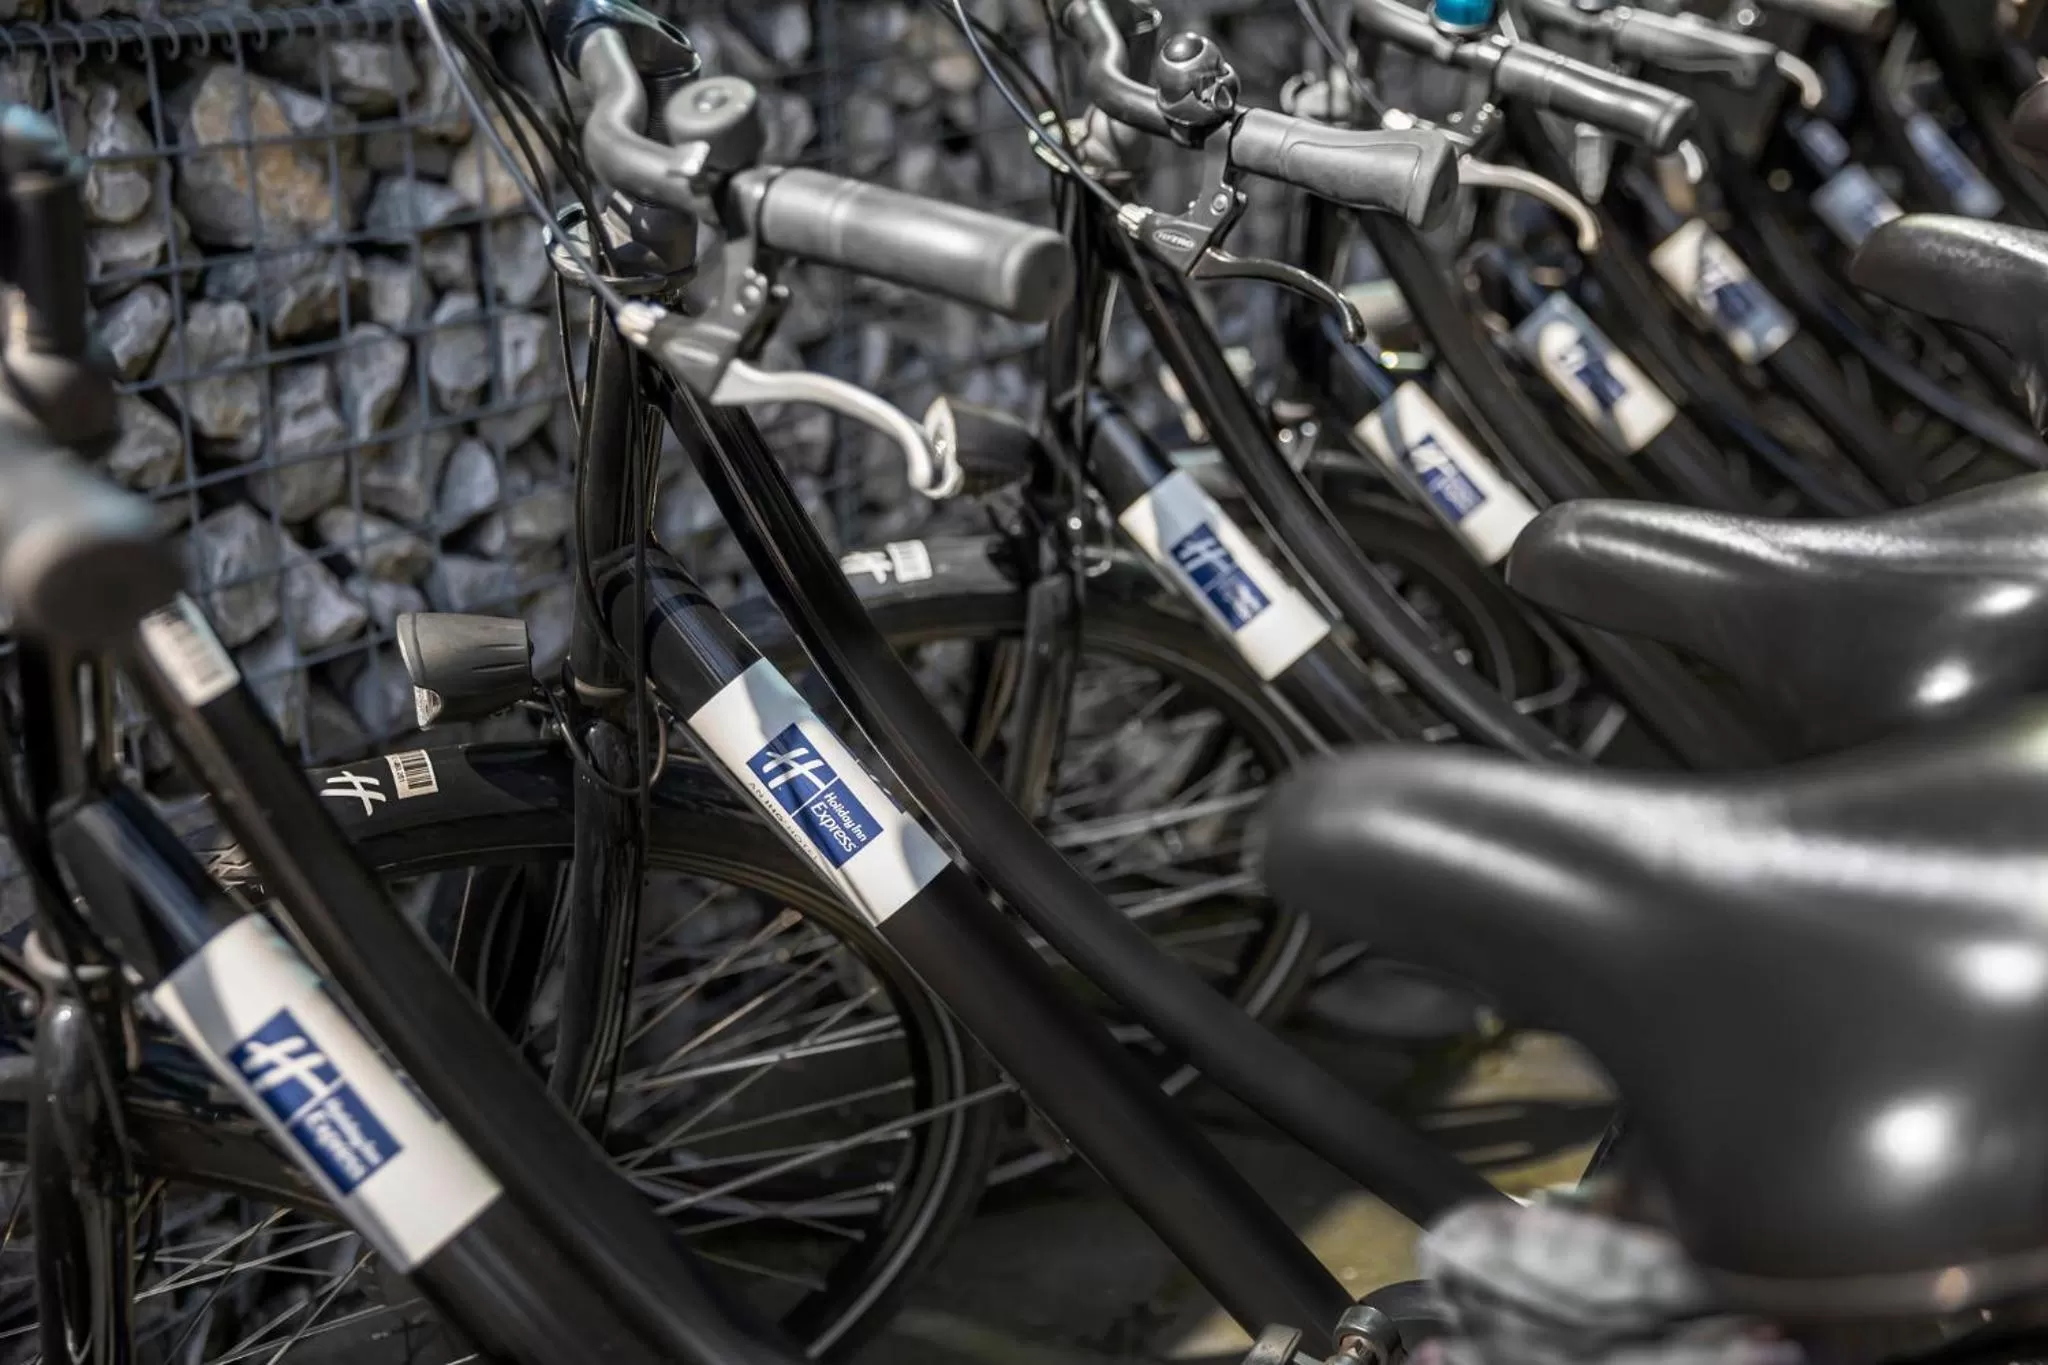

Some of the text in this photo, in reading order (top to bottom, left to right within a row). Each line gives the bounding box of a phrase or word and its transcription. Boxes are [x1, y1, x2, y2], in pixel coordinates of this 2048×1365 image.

[811, 801, 857, 852] Express
[824, 792, 867, 842] Holiday Inn
